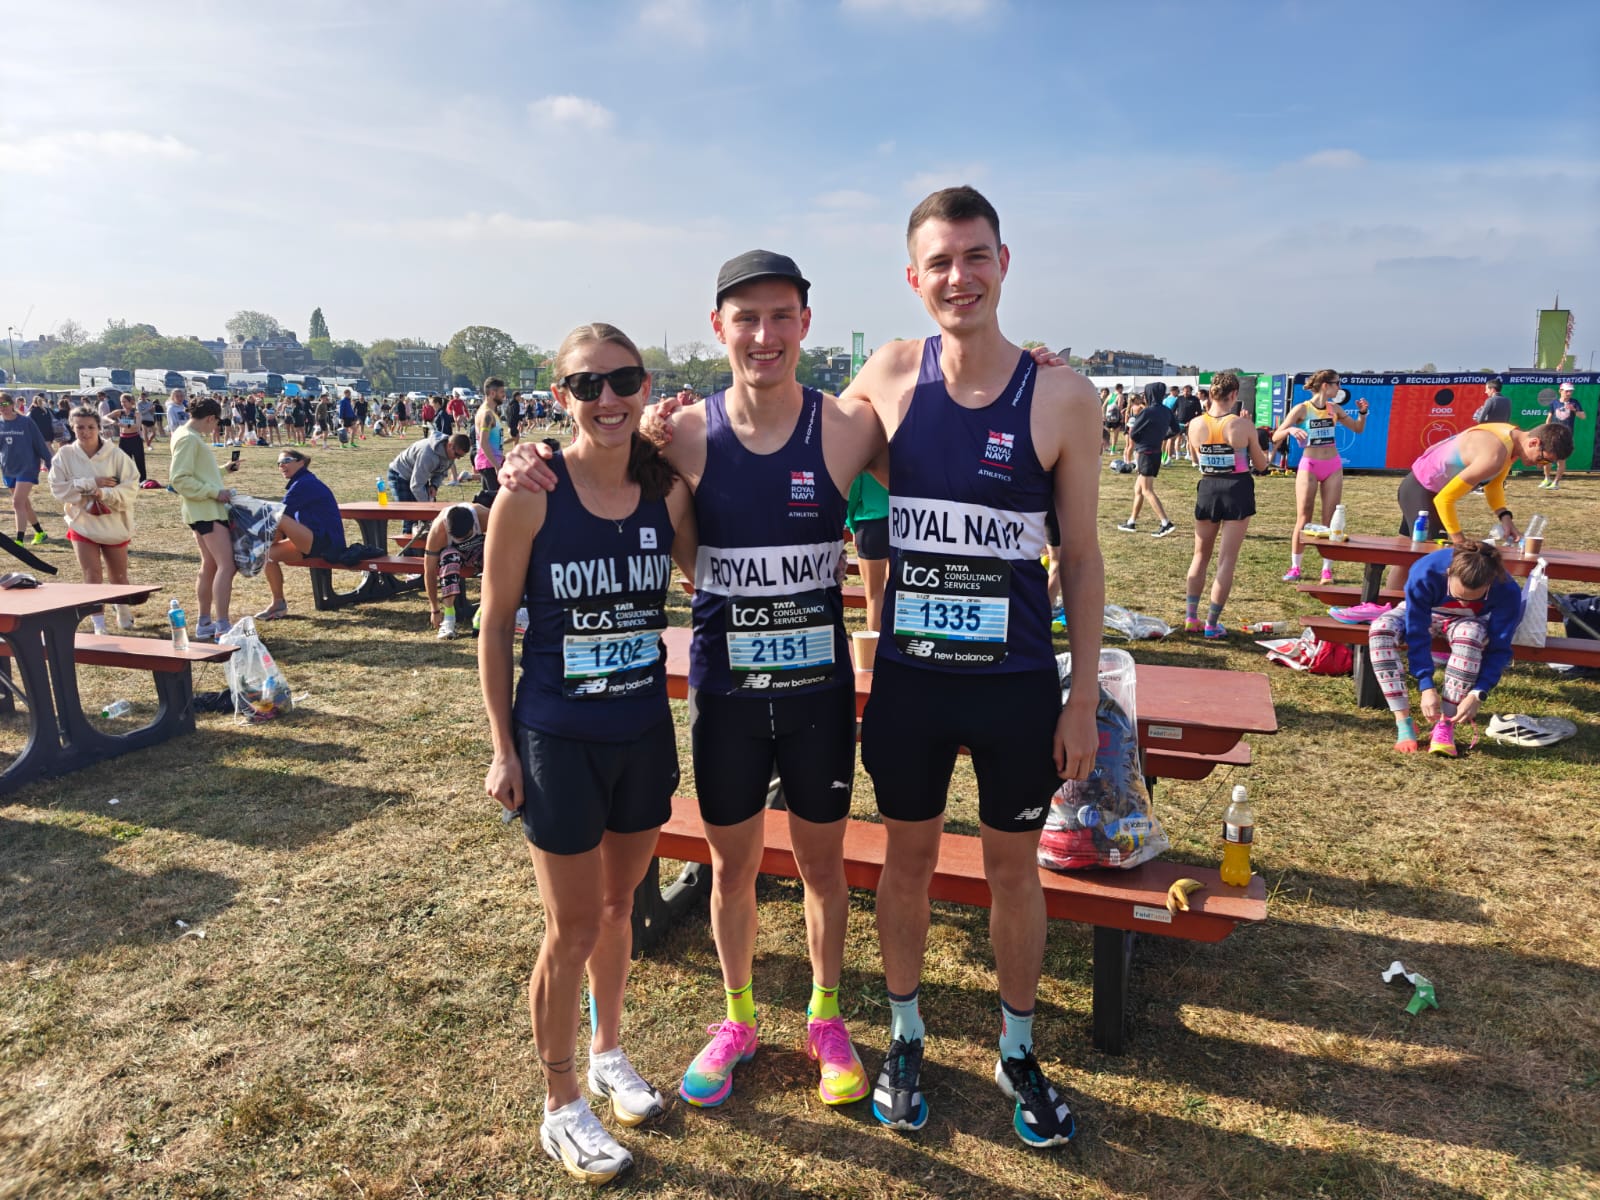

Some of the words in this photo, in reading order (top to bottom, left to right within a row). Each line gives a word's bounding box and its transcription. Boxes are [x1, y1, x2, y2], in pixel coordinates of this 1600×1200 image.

[1350, 376, 1384, 384] STATION
[1405, 376, 1450, 384] RECYCLING
[984, 450, 1011, 462] NAVY
[986, 444, 1012, 456] ROYAL
[1207, 456, 1226, 465] 1071
[978, 468, 1012, 482] ATHLETICS
[791, 486, 816, 494] ROYAL
[892, 506, 958, 544] ROYAL
[964, 514, 1025, 551] NAVY
[710, 556, 777, 588] ROYAL
[944, 563, 969, 572] TATA
[550, 557, 623, 600] ROYAL
[902, 561, 940, 588] tcs
[944, 572, 1002, 582] CONSULTANCY
[943, 581, 981, 590] SERVICES
[613, 602, 634, 610] TATA
[772, 601, 797, 609] TATA
[772, 605, 825, 617] CONSULTANCY
[572, 609, 613, 630] tcs
[615, 609, 659, 619] CONSULTANCY
[731, 603, 770, 626] tcs
[920, 602, 981, 631] 1335
[616, 618, 647, 628] SERVICES
[773, 616, 808, 625] SERVICES
[590, 638, 643, 667] 1202
[751, 636, 808, 662] 2151
[934, 651, 953, 660] new
[954, 652, 994, 662] balance
[608, 684, 627, 692] new
[625, 676, 654, 690] balance
[772, 681, 791, 689] new
[791, 675, 826, 688] balance
